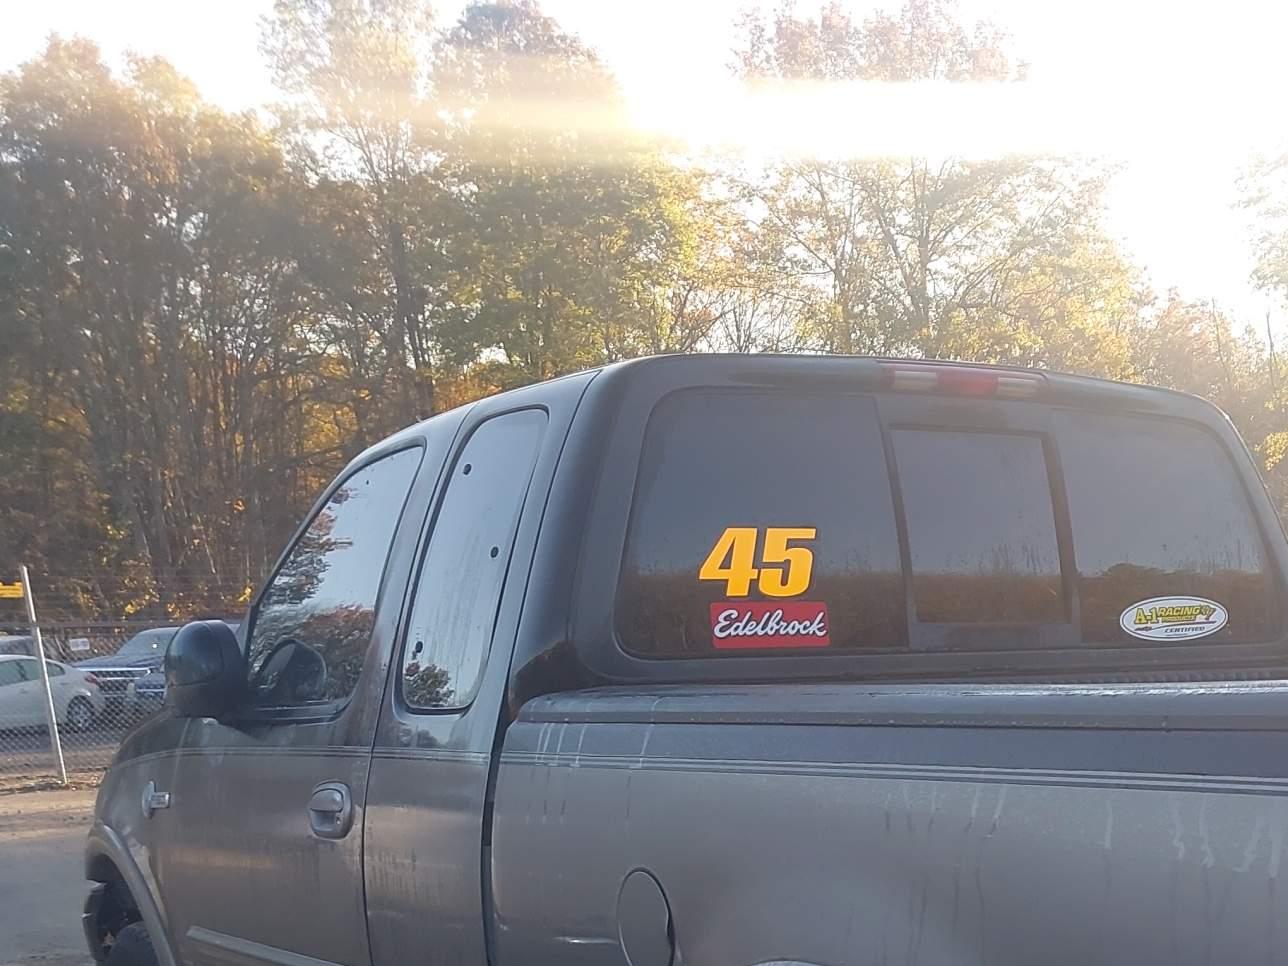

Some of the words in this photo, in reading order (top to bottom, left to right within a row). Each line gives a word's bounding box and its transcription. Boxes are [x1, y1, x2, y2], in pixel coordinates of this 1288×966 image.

[698, 527, 816, 597] 45
[713, 609, 827, 638] Edelbrock
[1134, 607, 1159, 625] A-1
[1158, 605, 1201, 617] RACING
